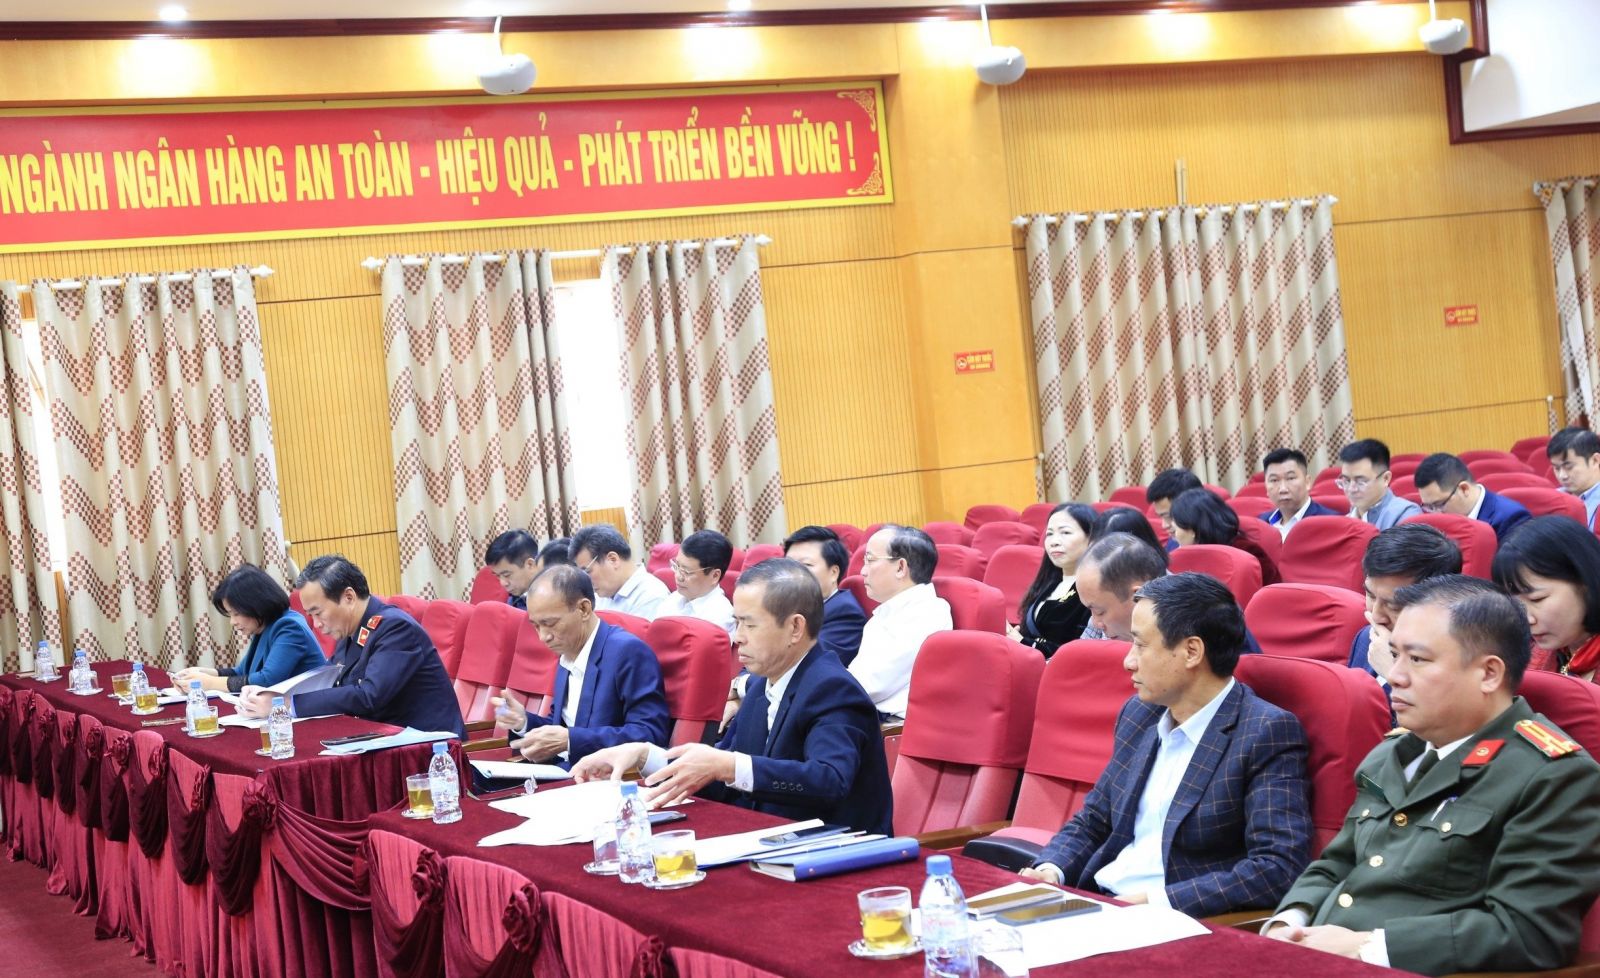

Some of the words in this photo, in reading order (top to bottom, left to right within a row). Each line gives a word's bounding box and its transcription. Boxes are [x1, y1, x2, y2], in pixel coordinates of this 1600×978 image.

[0, 141, 109, 214] NGÀNH
[113, 137, 202, 210] NGÂN
[205, 135, 288, 206] HÀNG
[295, 144, 336, 202] AN
[338, 131, 414, 199] TOÀN
[436, 127, 499, 206] HIỆU
[504, 112, 559, 198] QUẢ
[579, 120, 643, 187] PHÁT
[648, 106, 721, 184] TRIỂN
[724, 106, 775, 179] BỀN
[777, 109, 842, 176] VỮNG
